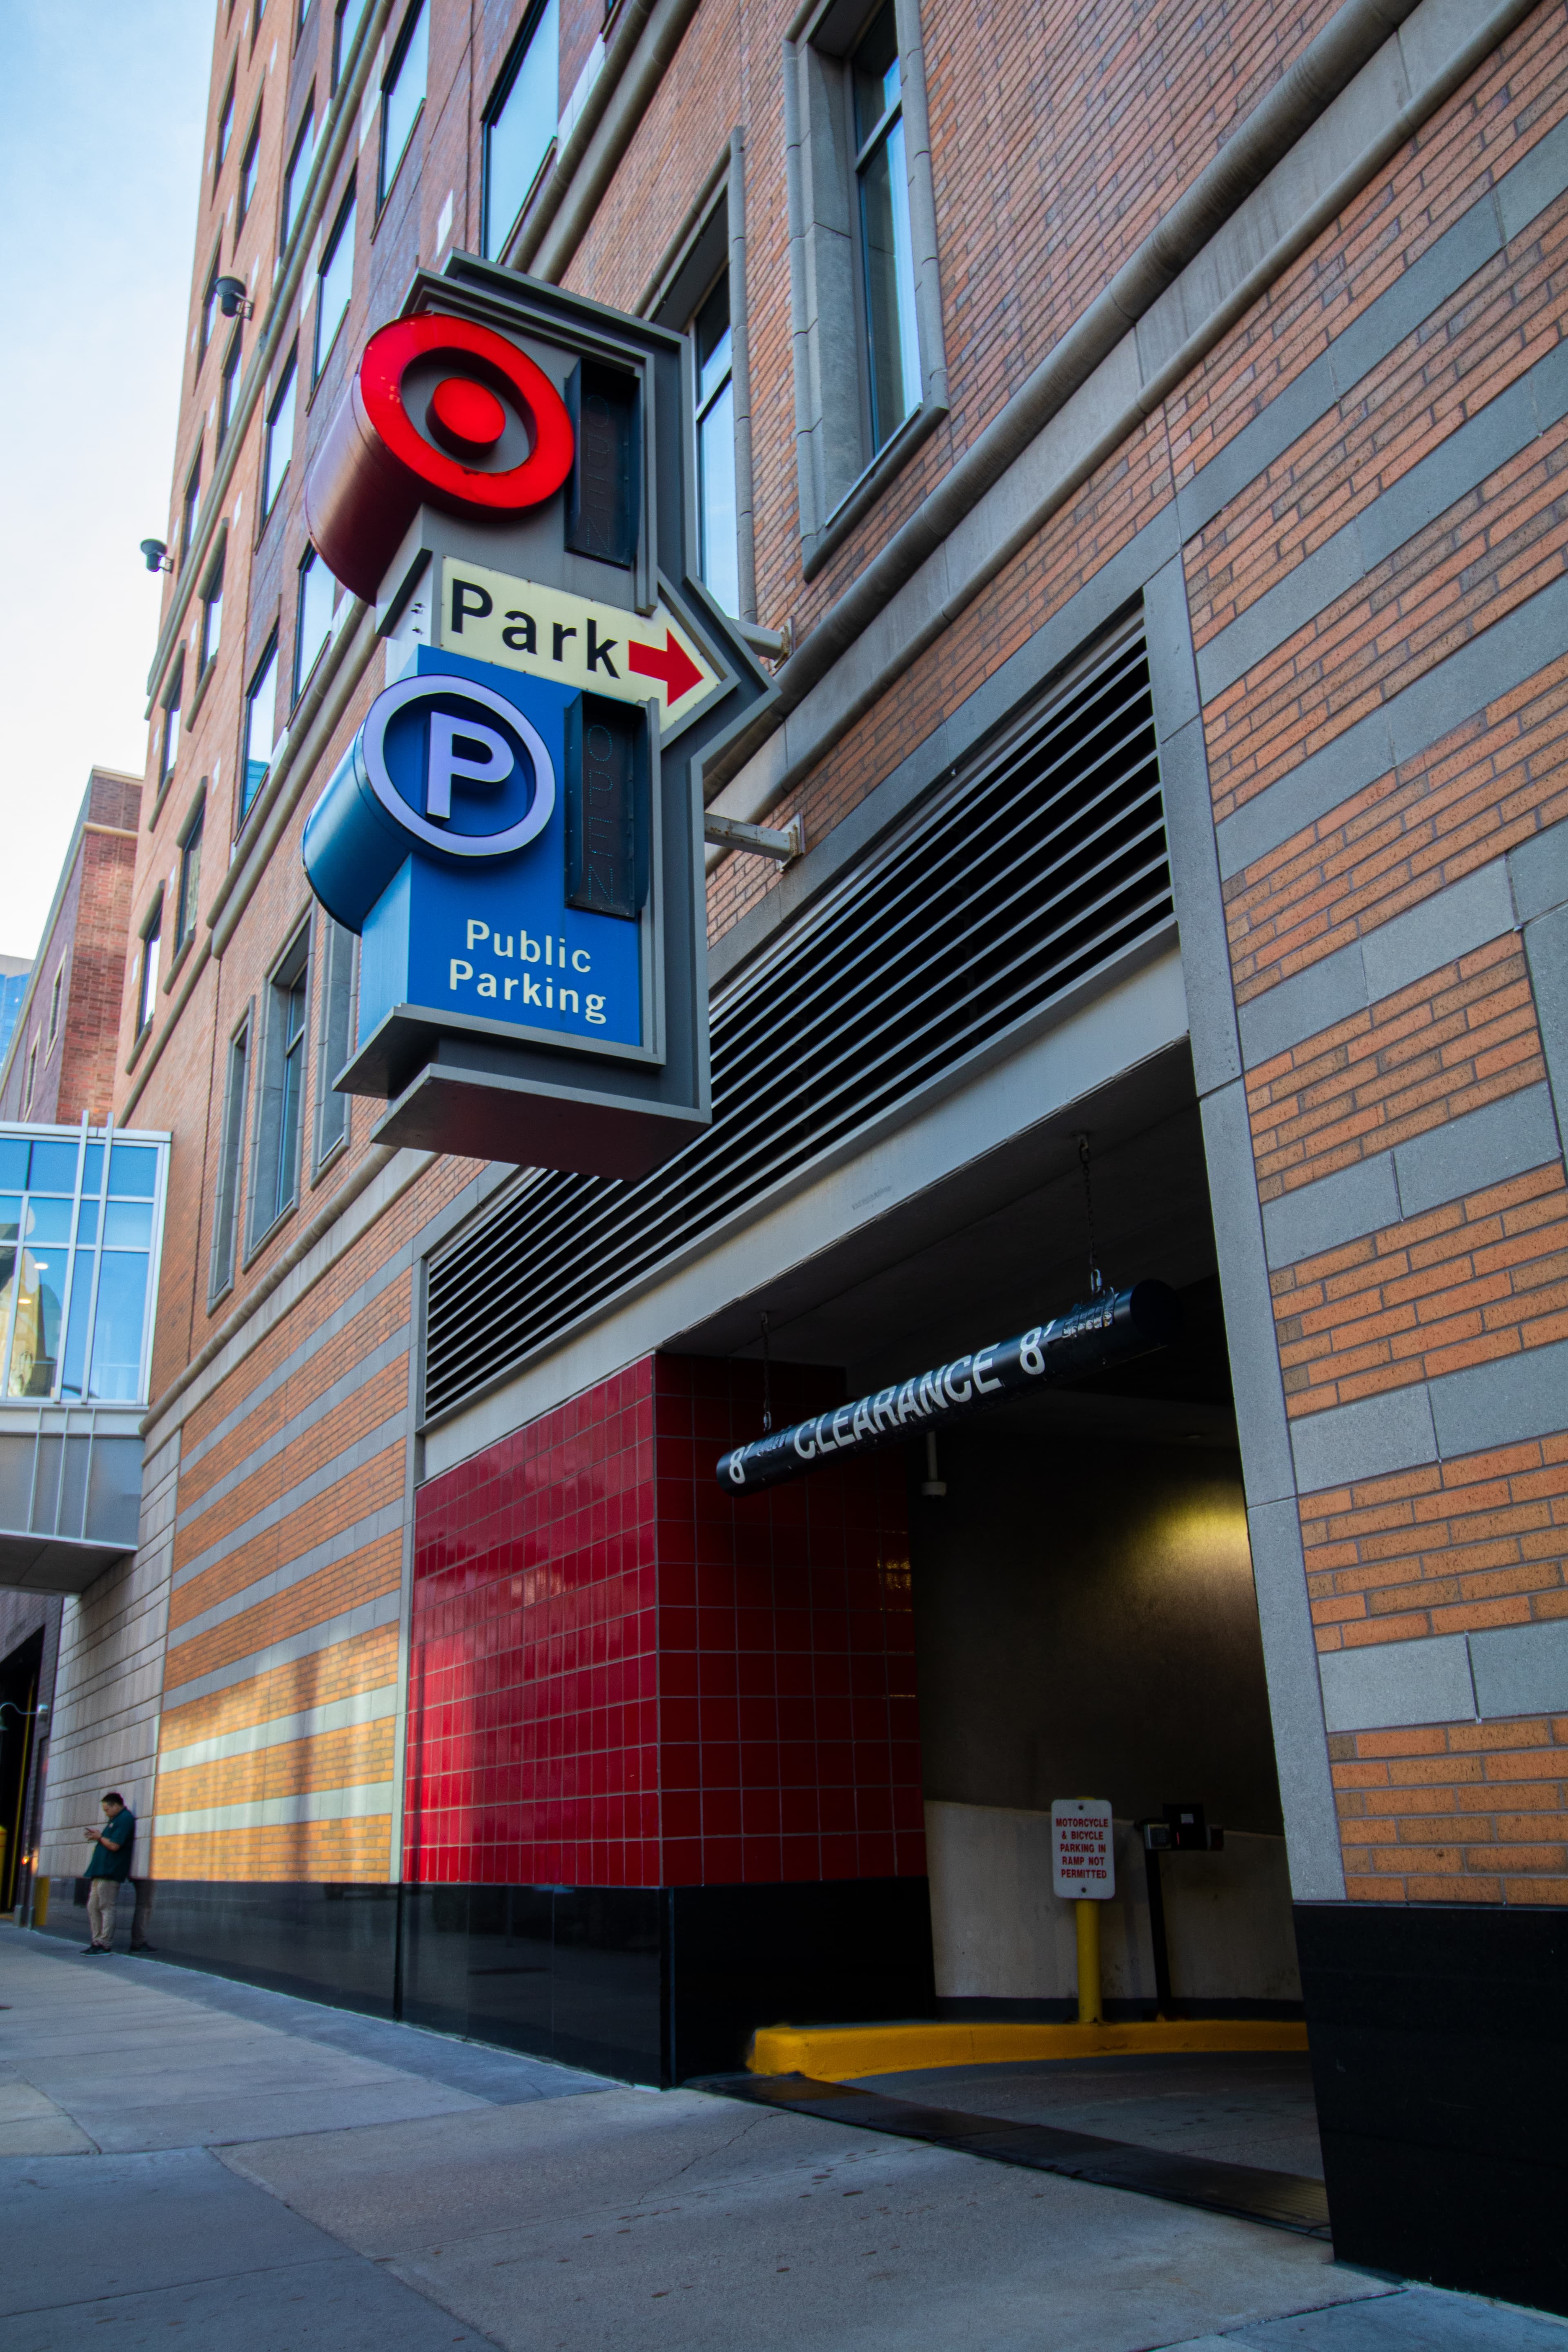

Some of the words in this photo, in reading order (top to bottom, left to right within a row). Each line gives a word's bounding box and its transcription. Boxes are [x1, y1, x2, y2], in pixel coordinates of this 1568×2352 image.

[451, 578, 621, 679] Park
[427, 711, 514, 819] P
[588, 724, 613, 904] OPEN
[466, 919, 592, 973] Public
[449, 959, 607, 1025] Parking
[794, 1343, 1003, 1459] CLEARANCE
[1056, 1818, 1108, 1827] MOTORCYCLE
[1060, 1844, 1094, 1853] PARKING
[1098, 1844, 1106, 1853] IN
[1062, 1831, 1067, 1840] &
[1071, 1831, 1104, 1840] BICYCLE
[1061, 1869, 1107, 1878] PERMITTED
[1062, 1856, 1085, 1865] RAMP
[1089, 1857, 1105, 1866] NOT
